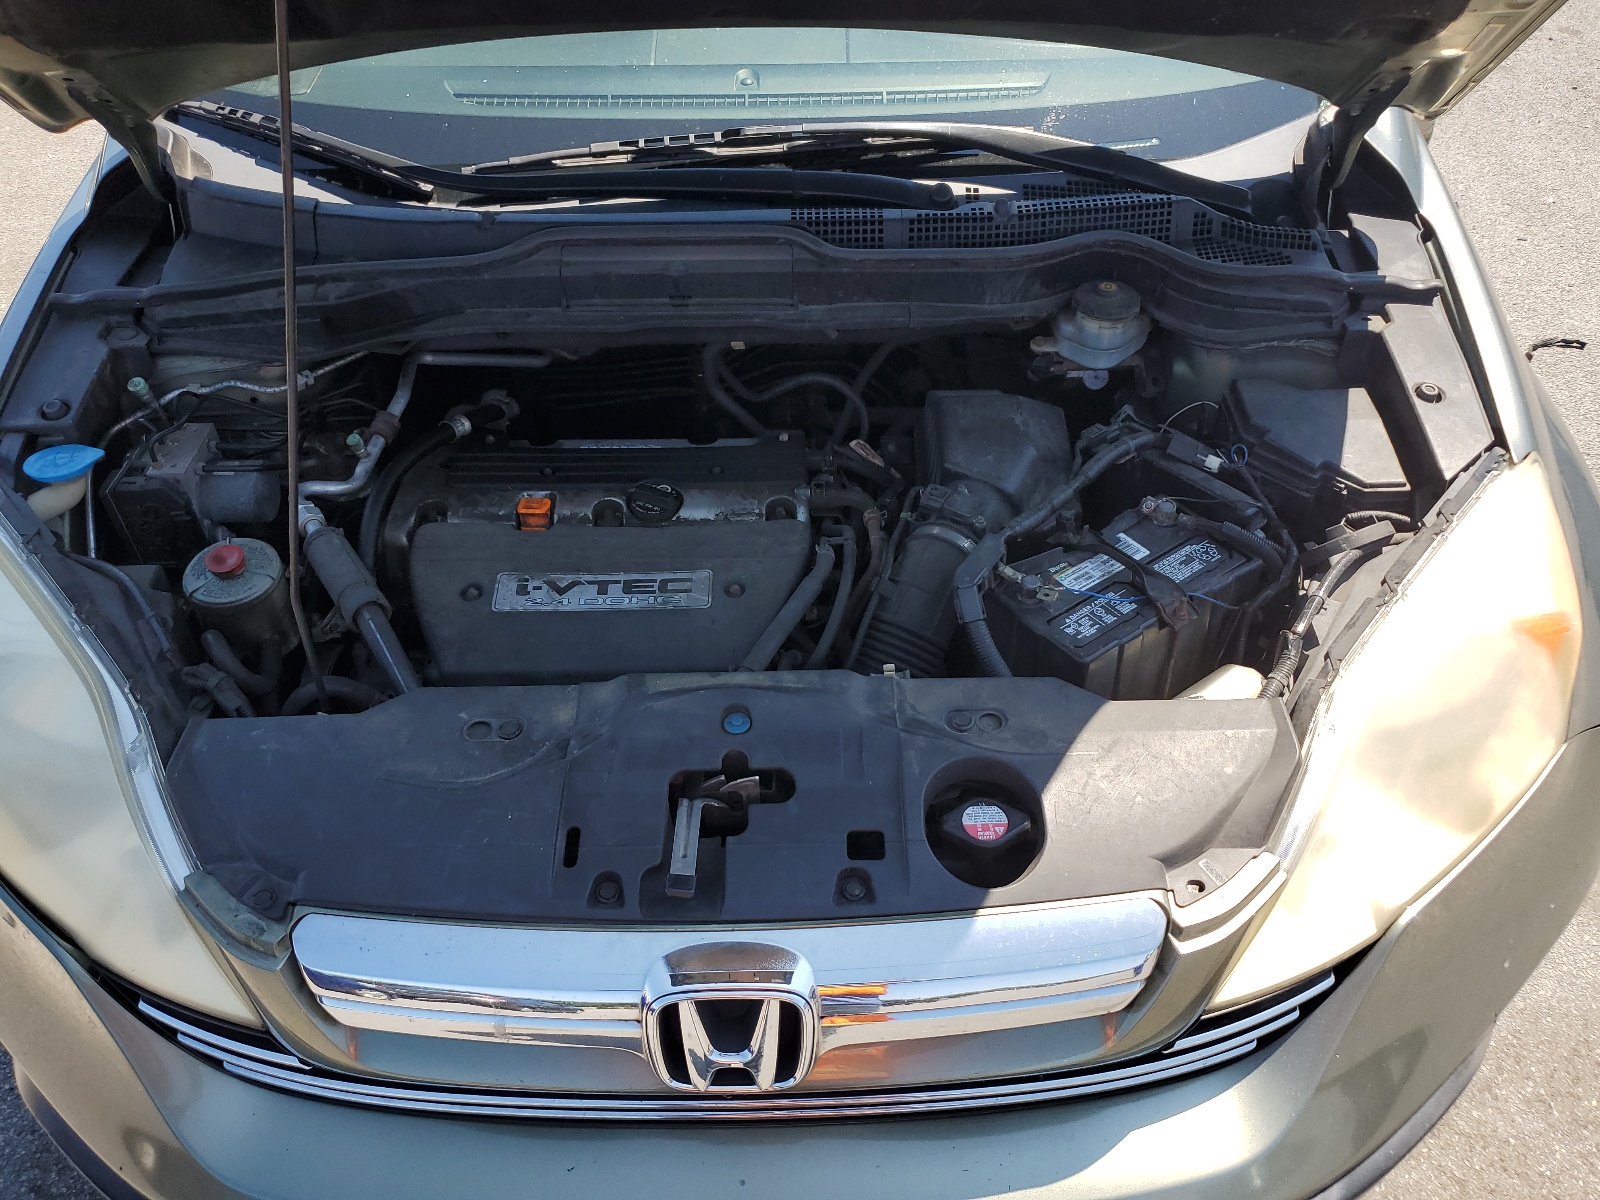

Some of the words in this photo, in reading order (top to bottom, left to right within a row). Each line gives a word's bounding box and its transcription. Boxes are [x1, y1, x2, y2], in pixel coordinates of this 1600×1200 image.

[515, 577, 694, 596] i-VTEC
[523, 597, 572, 607] 2.4
[1094, 591, 1116, 605] POION
